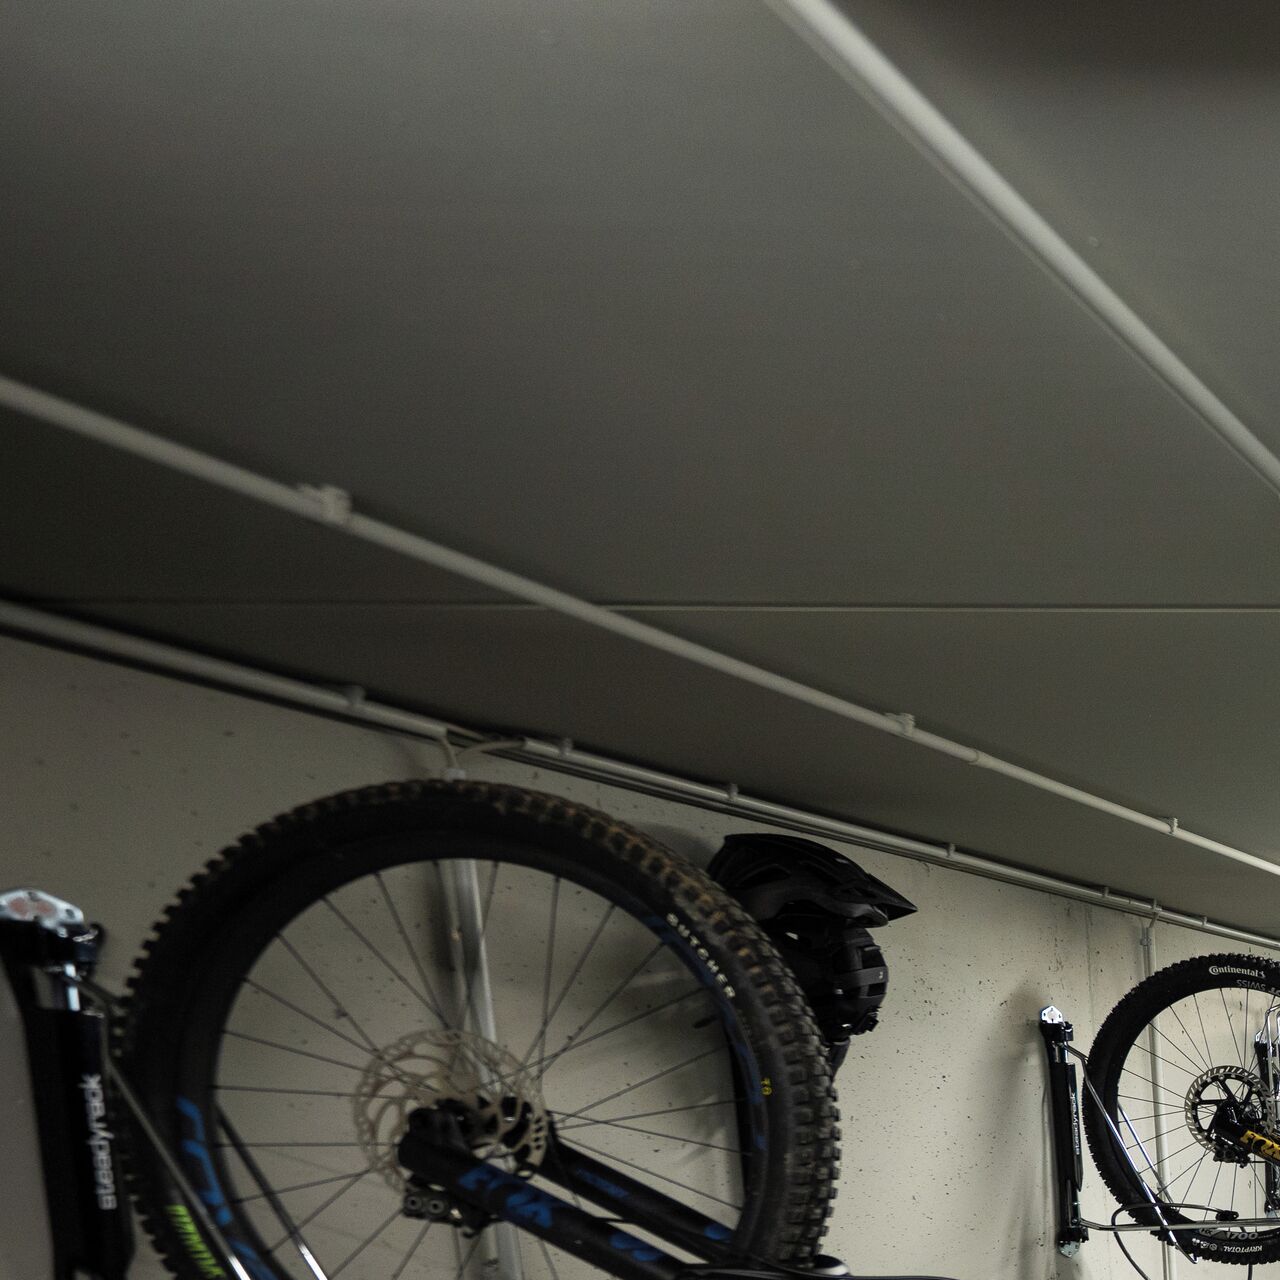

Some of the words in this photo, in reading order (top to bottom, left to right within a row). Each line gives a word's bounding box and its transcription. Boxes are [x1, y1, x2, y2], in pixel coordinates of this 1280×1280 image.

[1208, 965, 1258, 977] Continental
[77, 1072, 116, 1211] steadyrack
[1069, 1092, 1080, 1155] steadyrack
[1223, 1245, 1263, 1254] KRYPTOTAL
